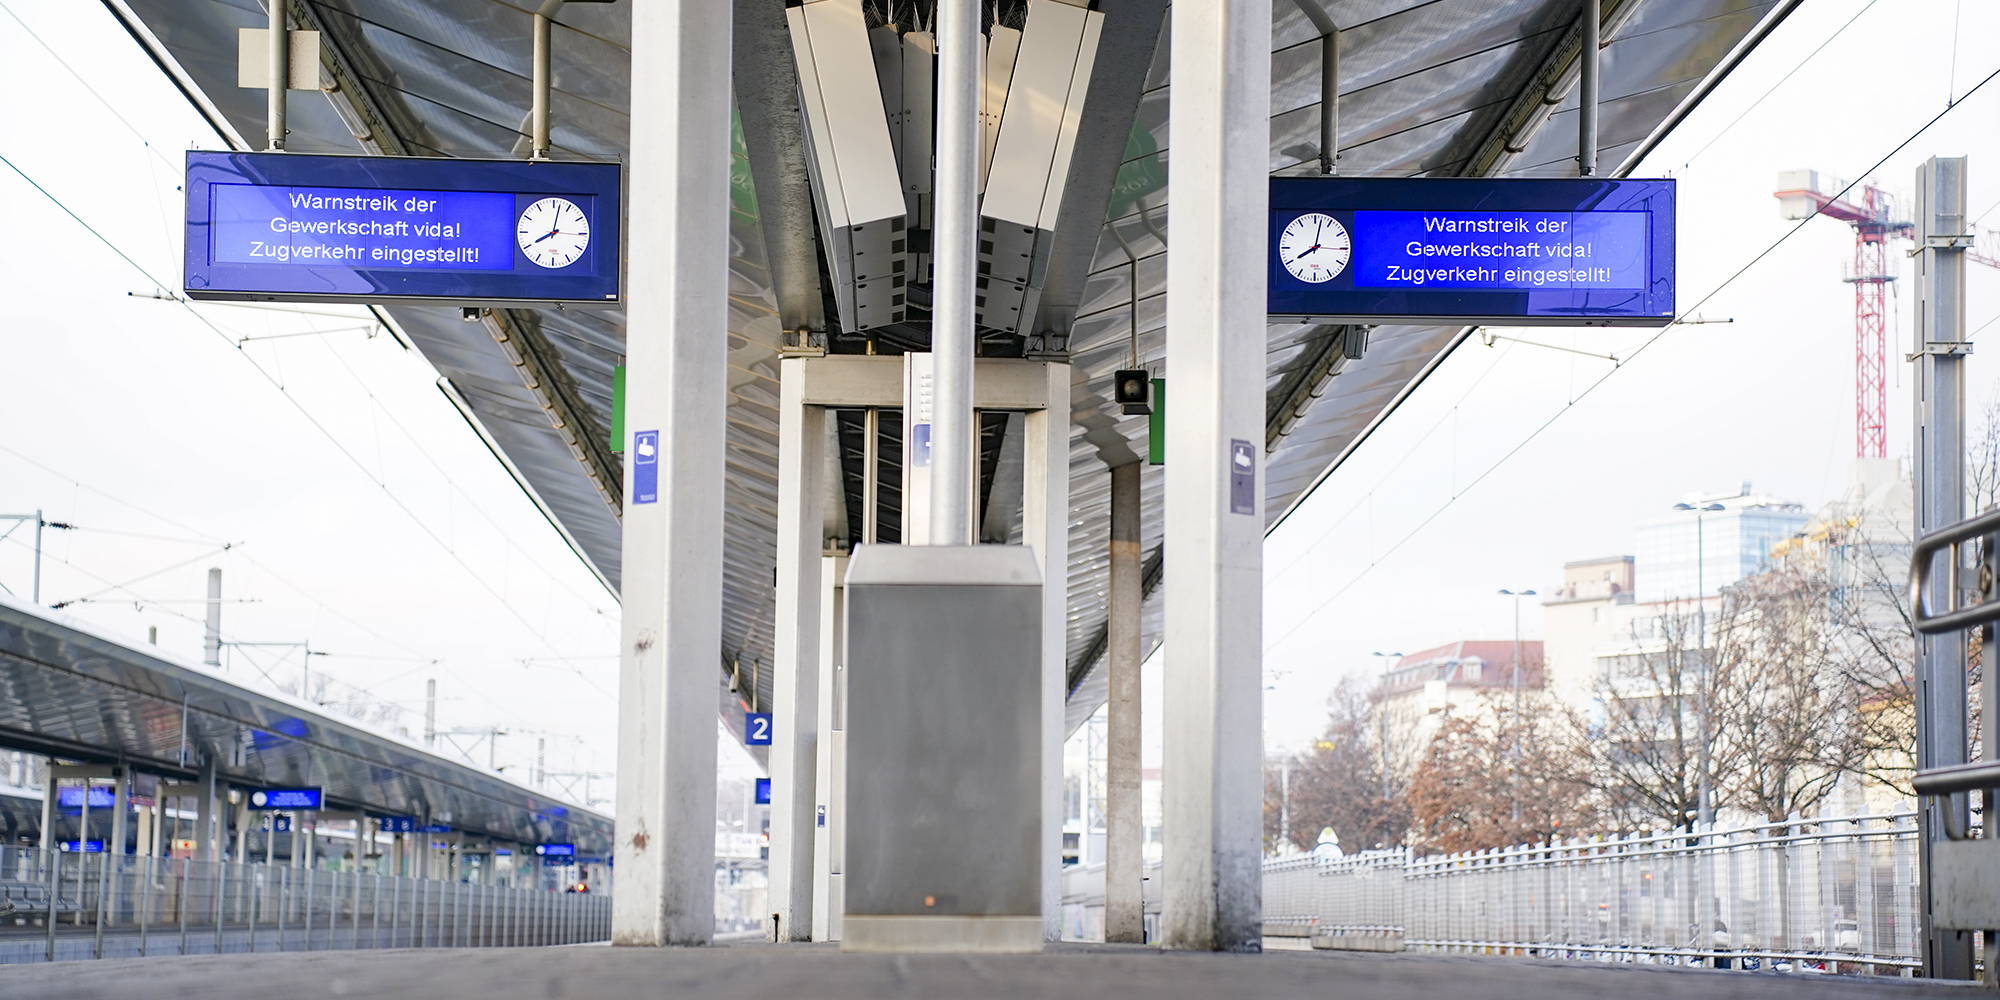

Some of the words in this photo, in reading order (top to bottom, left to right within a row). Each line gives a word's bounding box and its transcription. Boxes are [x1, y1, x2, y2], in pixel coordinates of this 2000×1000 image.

[288, 192, 398, 211] Warnstreik
[403, 196, 437, 212] der
[270, 217, 409, 236] Gewerkschaft
[413, 222, 461, 238] vida!
[1423, 216, 1530, 233] Warnstreik
[1535, 217, 1568, 233] der
[249, 241, 366, 261] Zugverkehr
[371, 245, 479, 265] eingestellt!
[1406, 241, 1541, 257] Gewerkschaft
[1545, 242, 1592, 258] vida!
[1386, 265, 1498, 285] Zugverkehr
[1504, 267, 1611, 286] eingestellt!
[752, 717, 768, 739] 2
